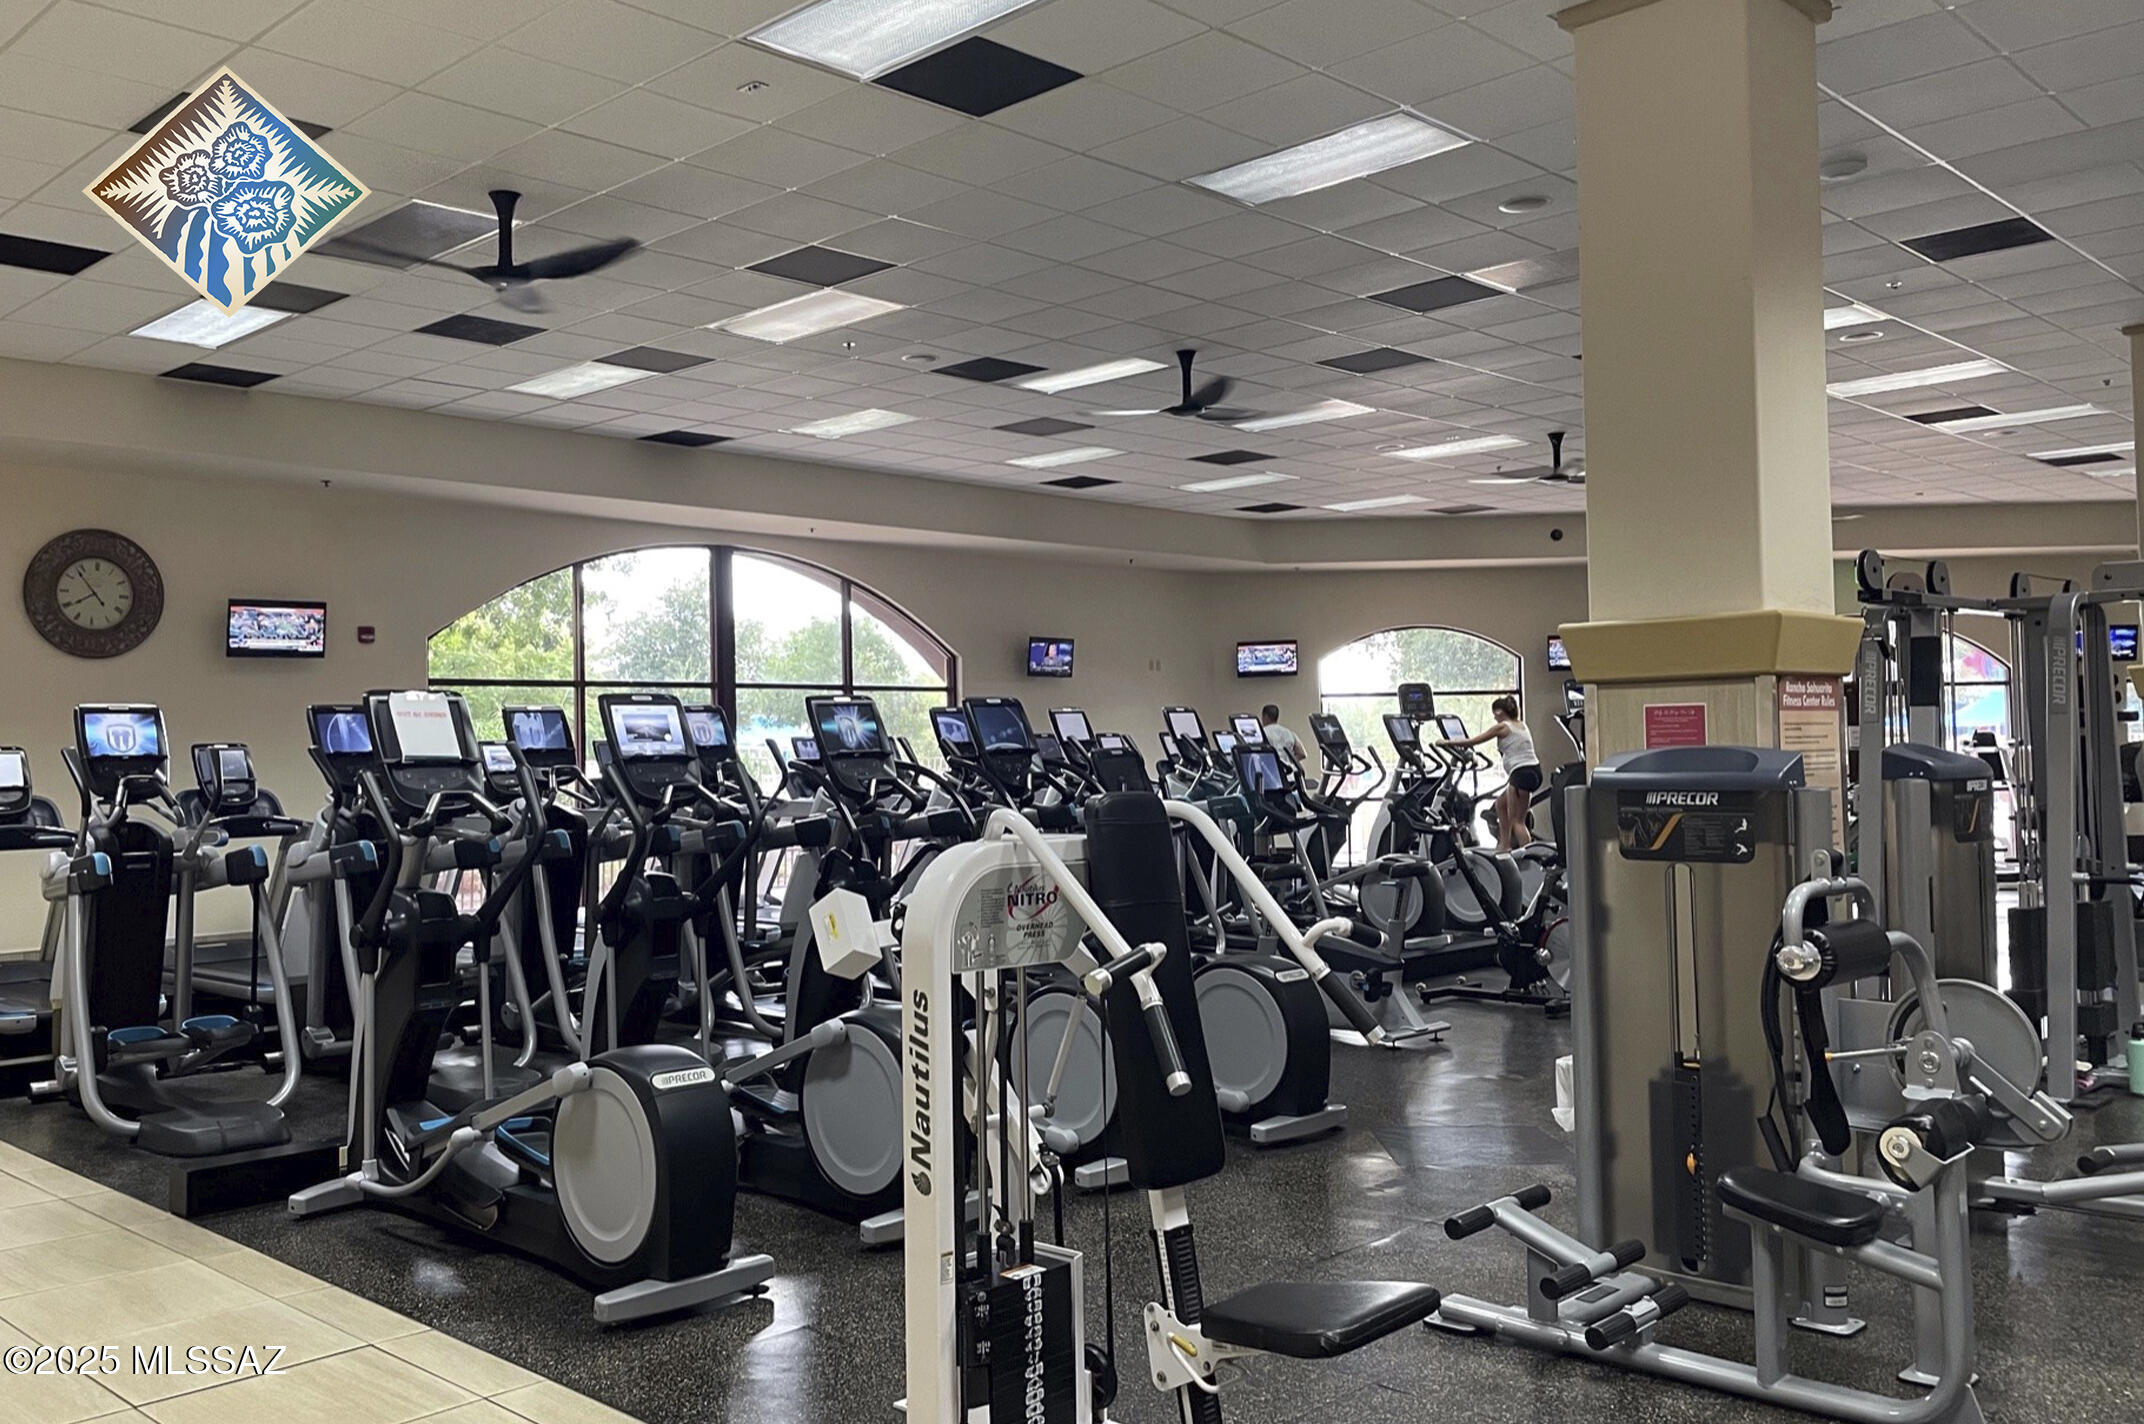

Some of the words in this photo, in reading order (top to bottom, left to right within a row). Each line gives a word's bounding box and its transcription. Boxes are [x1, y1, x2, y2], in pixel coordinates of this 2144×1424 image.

[2052, 645, 2067, 705] PRECOR
[1864, 657, 1877, 715] PRECOR
[1783, 694, 1802, 707] Fitness
[1803, 694, 1821, 707] Center
[1656, 791, 1719, 806] PRECOR
[1008, 891, 1057, 906] NITRO
[1016, 921, 1054, 932] OVERHEAD
[1023, 930, 1045, 938] PRESS
[668, 1070, 707, 1085] PRECOR
[909, 989, 932, 1172] Nautilus
